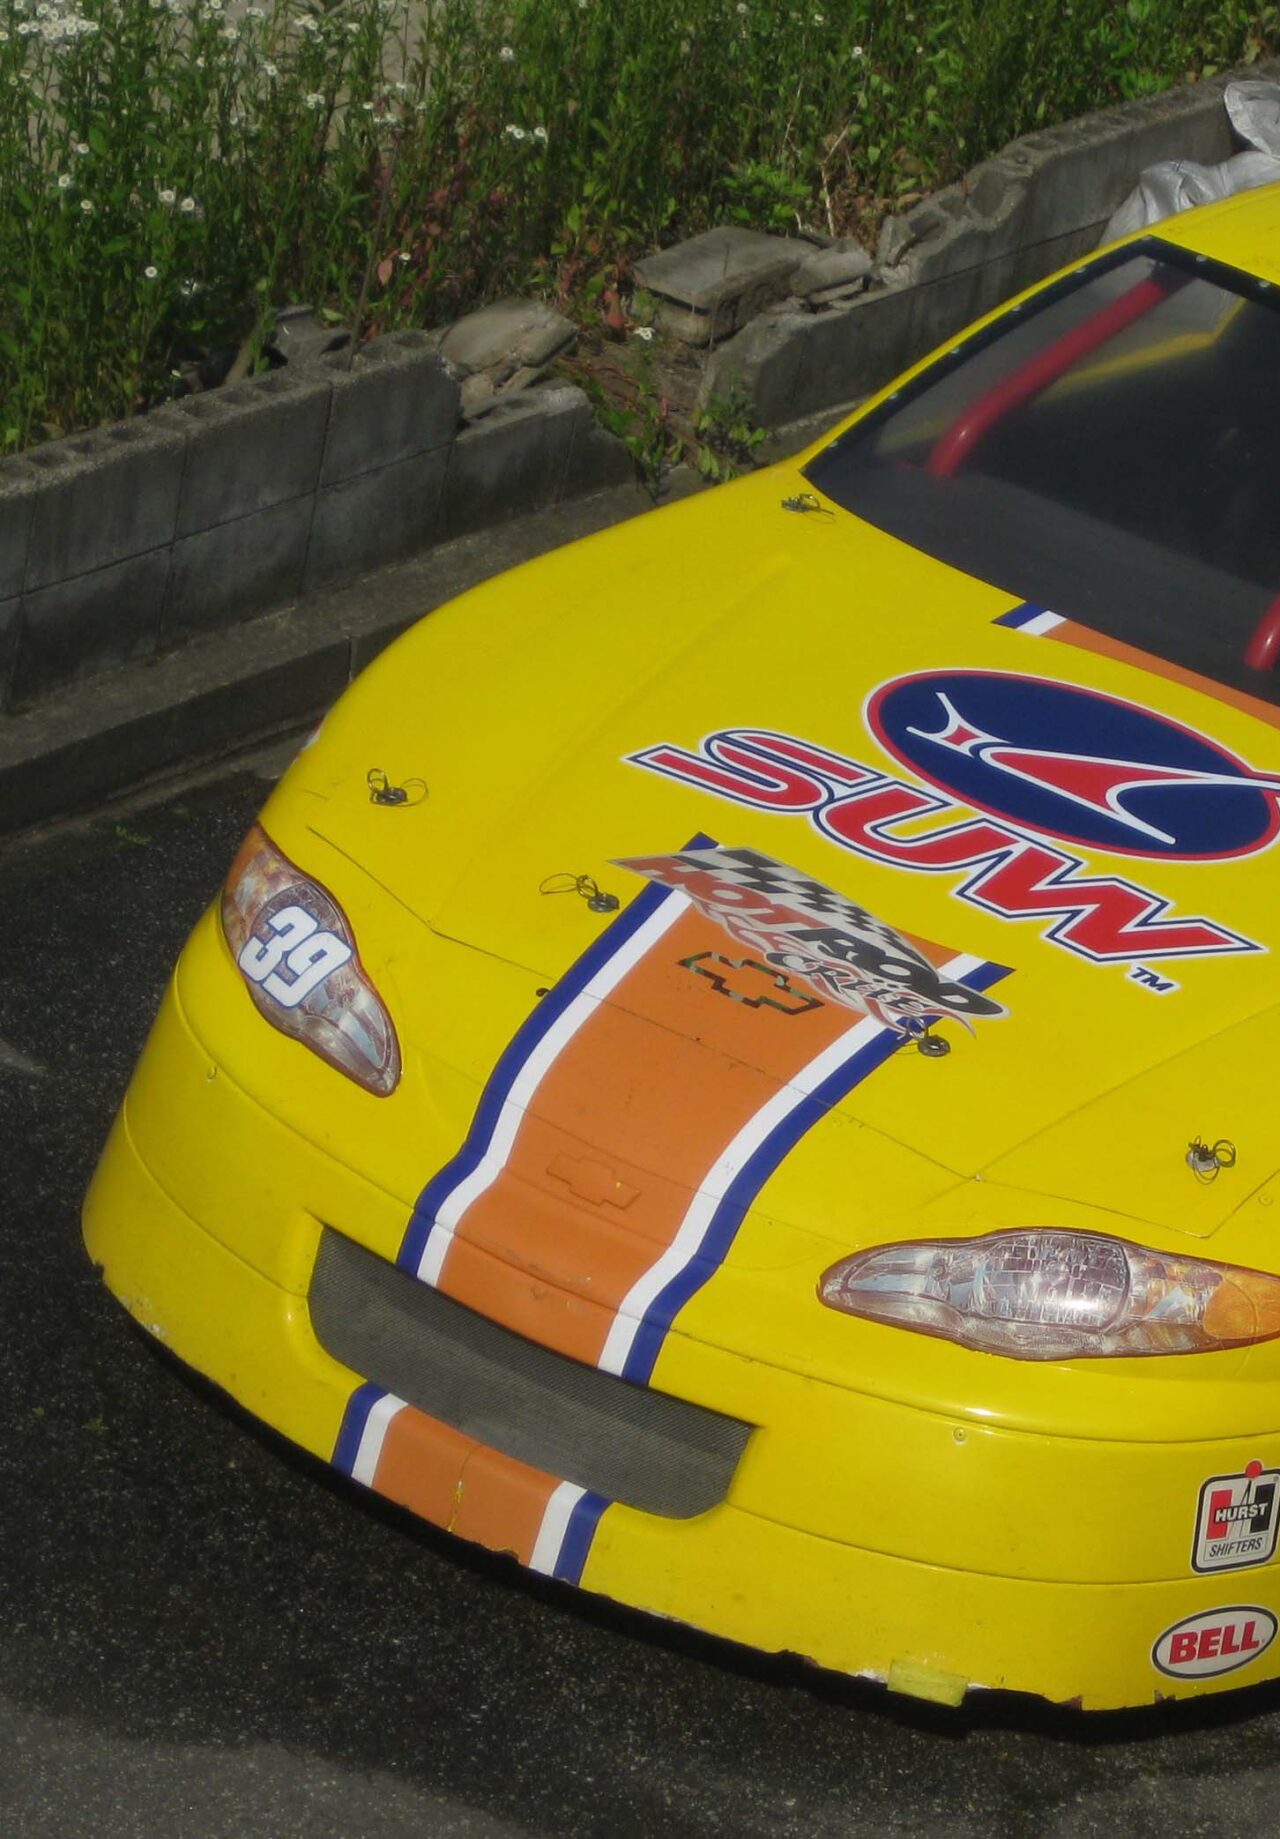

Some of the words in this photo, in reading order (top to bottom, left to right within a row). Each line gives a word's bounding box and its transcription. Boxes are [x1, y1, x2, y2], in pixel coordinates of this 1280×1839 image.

[239, 905, 352, 1008] 39
[1214, 1501, 1269, 1523] HURST
[1209, 1537, 1263, 1558] SHIFTERS
[1168, 1620, 1261, 1665] BELL
